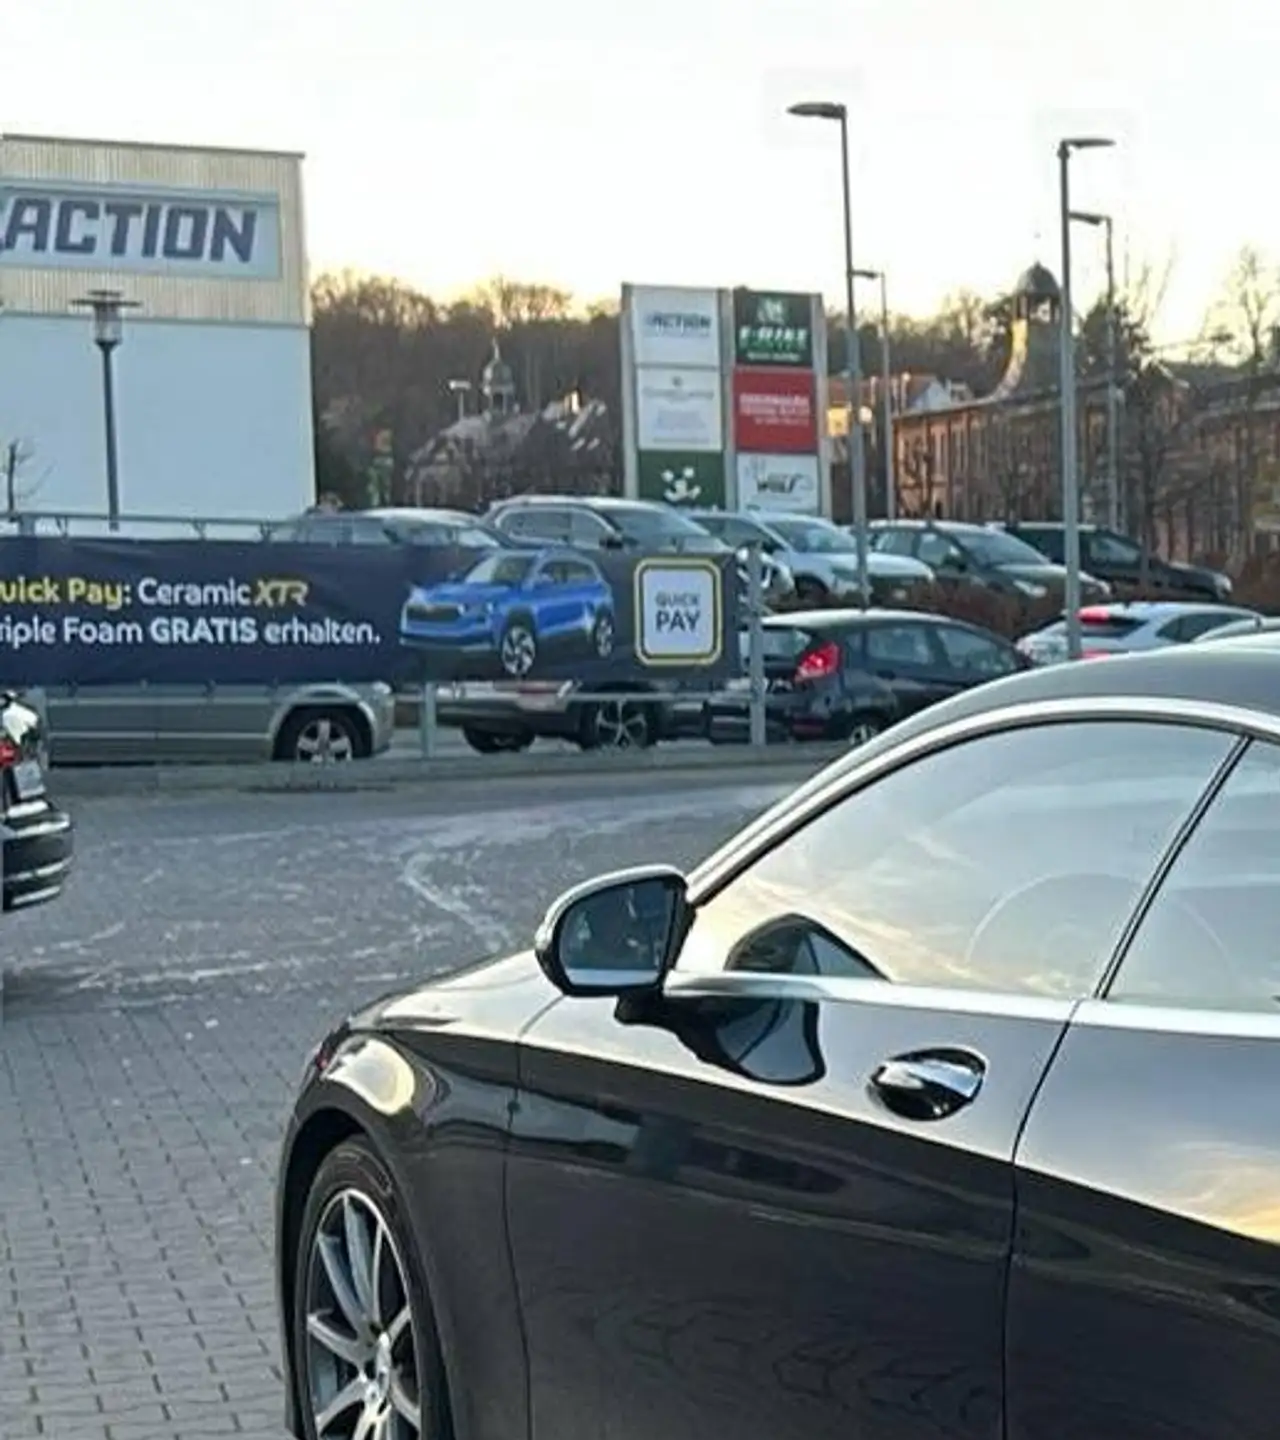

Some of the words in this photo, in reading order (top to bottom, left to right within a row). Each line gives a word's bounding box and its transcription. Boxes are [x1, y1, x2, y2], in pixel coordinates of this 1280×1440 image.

[3, 197, 258, 264] ACTION
[0, 576, 60, 603] uick
[68, 577, 132, 611] Pay:
[138, 577, 251, 606] Ceramic
[254, 579, 309, 608] XTR
[64, 616, 143, 643] Foam
[149, 615, 259, 644] GRATIS
[264, 613, 381, 644] erhalten.
[656, 609, 701, 633] PAY
